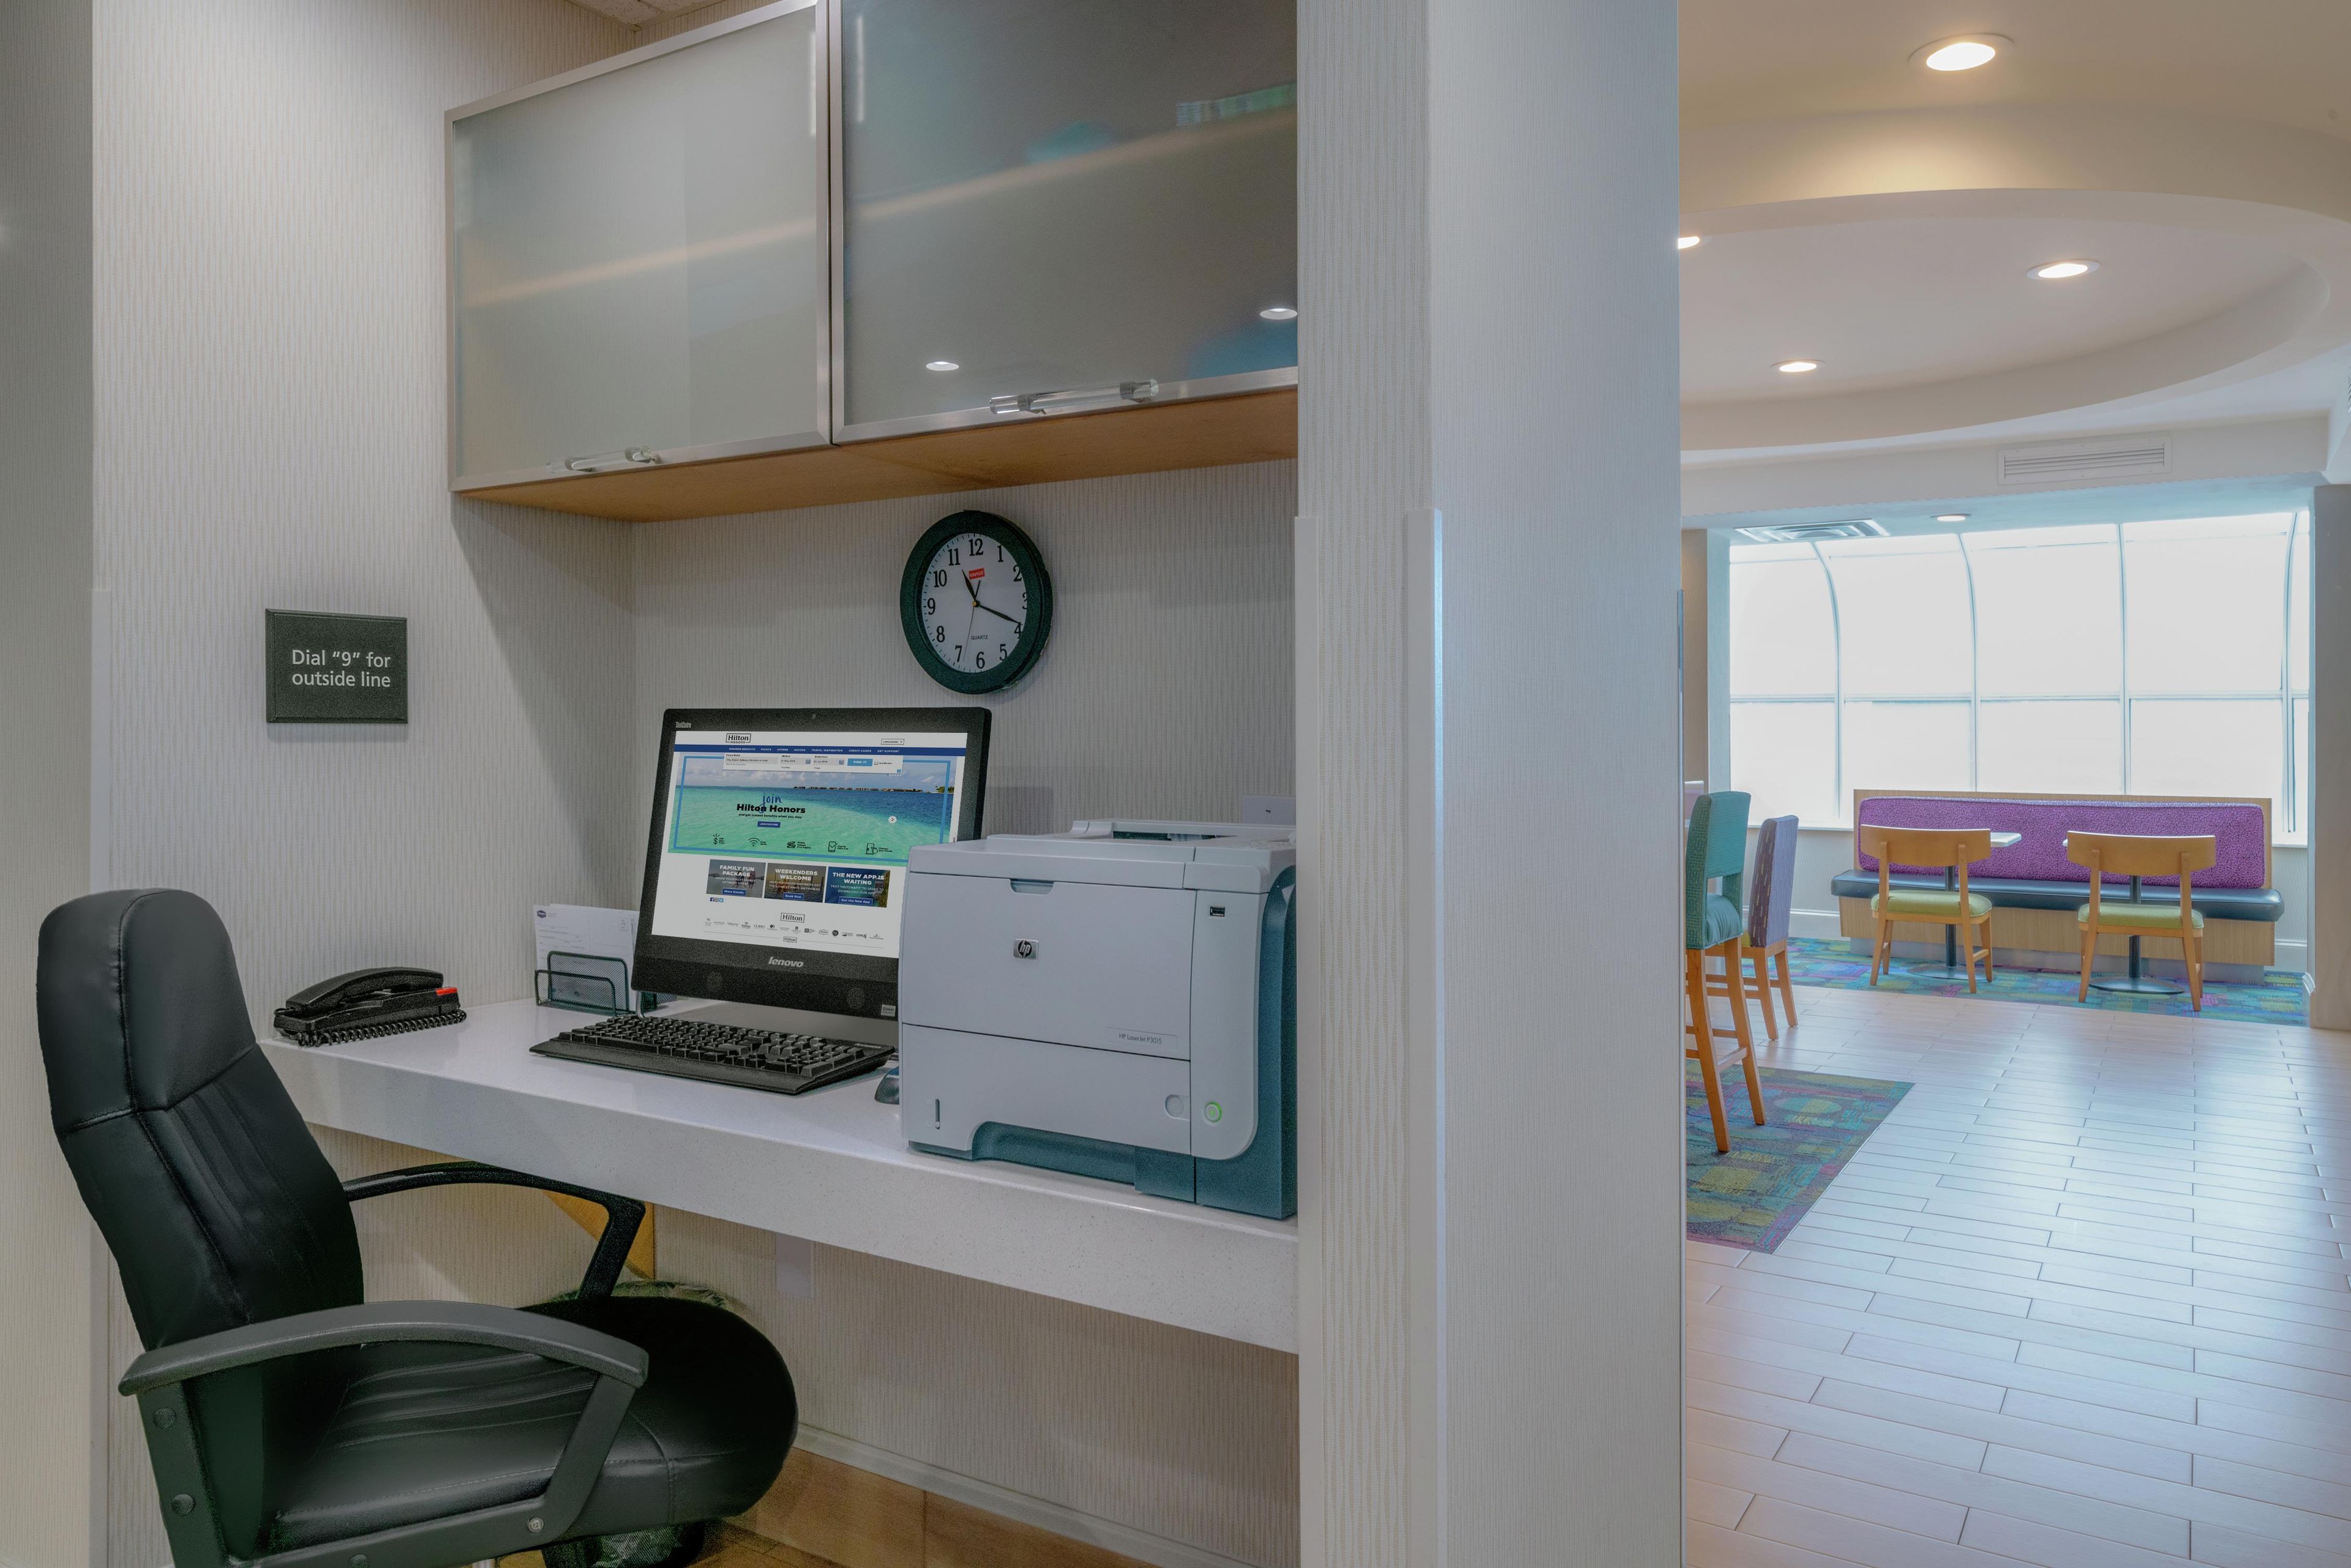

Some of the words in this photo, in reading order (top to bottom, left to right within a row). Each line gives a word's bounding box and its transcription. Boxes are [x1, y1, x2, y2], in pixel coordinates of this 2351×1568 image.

[969, 538, 984, 556] 12
[997, 545, 1003, 563] 1
[948, 548, 961, 566] 11
[934, 569, 947, 587] 10
[1013, 565, 1022, 582] 2
[927, 598, 936, 615] 9
[936, 625, 945, 643] 8
[1014, 621, 1021, 639] 4
[292, 650, 325, 666] Dial
[366, 652, 391, 667] for
[954, 645, 962, 662] 7
[976, 651, 985, 669] 6
[999, 643, 1007, 661] 5
[292, 670, 355, 686] outside
[361, 671, 391, 687] line
[759, 793, 782, 813] join
[1019, 940, 1031, 958] hp
[768, 956, 803, 967] lenovo
